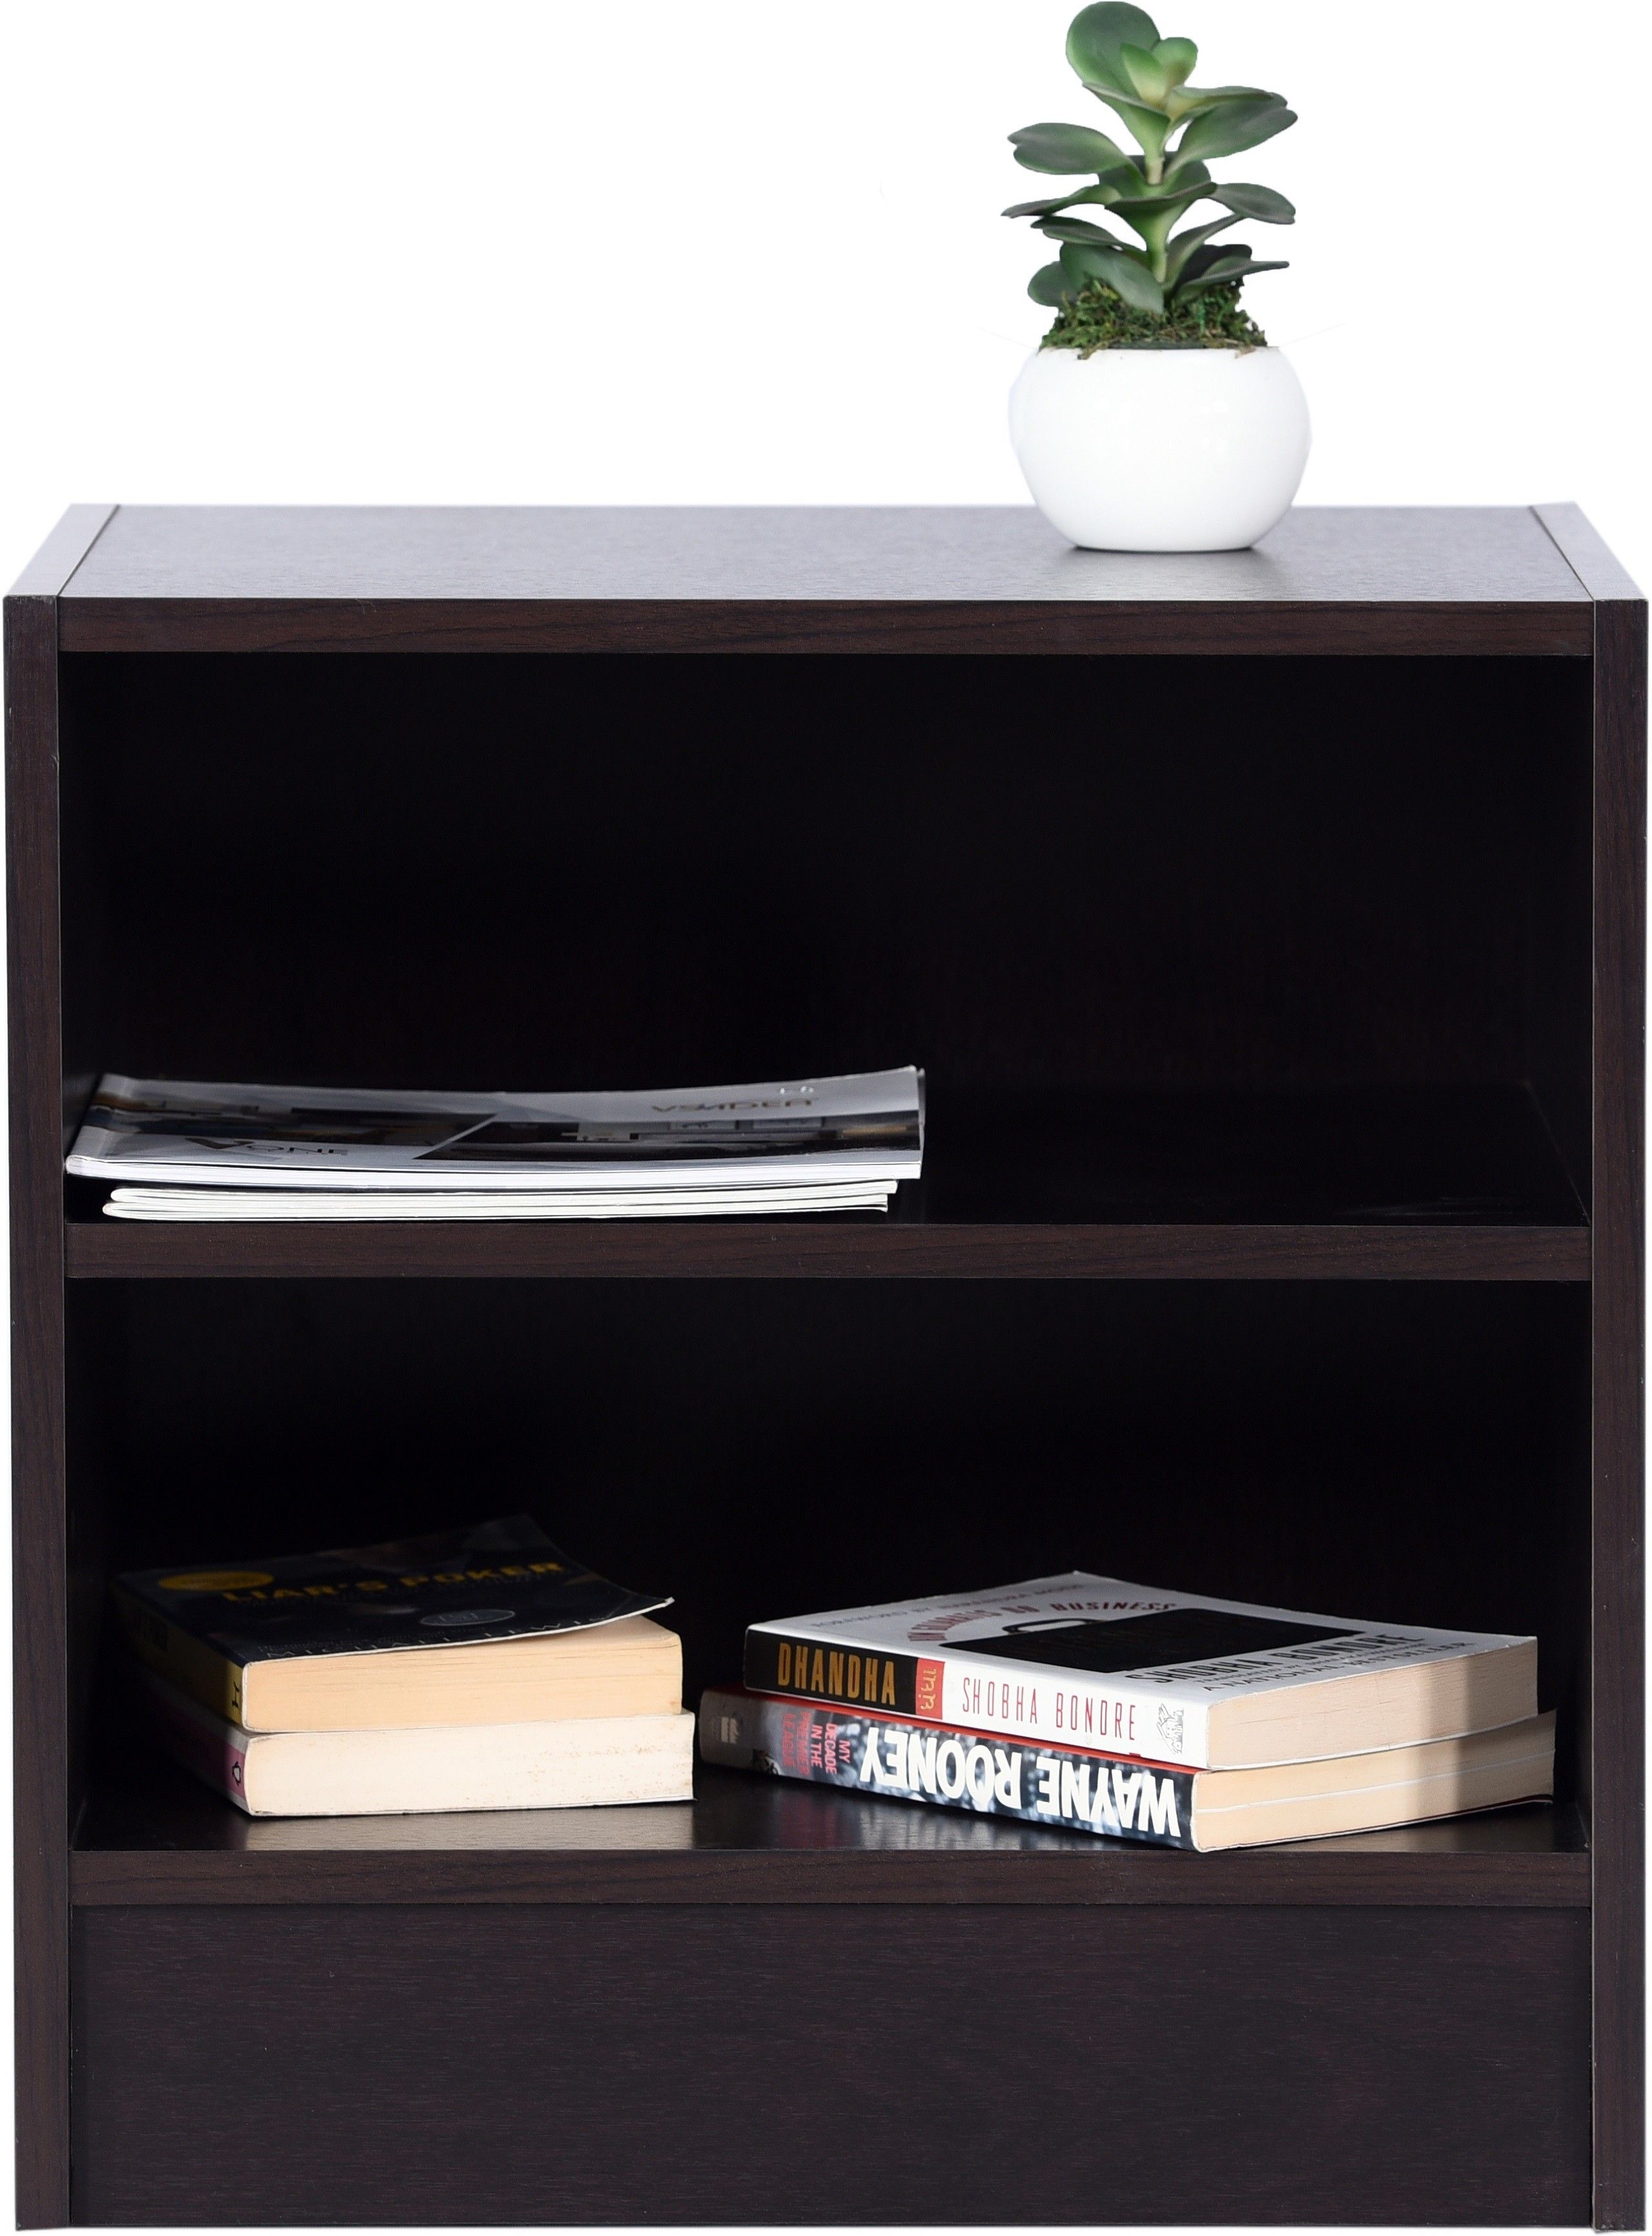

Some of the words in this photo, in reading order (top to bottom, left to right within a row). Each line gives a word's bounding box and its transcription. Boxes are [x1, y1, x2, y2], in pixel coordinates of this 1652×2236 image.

[221, 1579, 389, 1602] LIAR'S
[399, 1561, 564, 1588] POKER
[1049, 1601, 1176, 1611] BUSINESS
[777, 1642, 896, 1705] DHANDHA
[1125, 1659, 1283, 1683] SHOBHA
[1269, 1633, 1425, 1660] BONDRE
[1221, 1665, 1345, 1687] NATIONAL
[1341, 1641, 1475, 1667] BESTSELLER
[810, 1724, 823, 1740] IN
[962, 1676, 1038, 1725] SHOBHA
[1055, 1692, 1136, 1741] BONDRE
[782, 1713, 797, 1768] LEAGUE
[797, 1711, 811, 1776] PREMIER
[810, 1742, 823, 1769] THE
[824, 1723, 838, 1775] DECADE
[838, 1740, 851, 1763] MY
[859, 1726, 1022, 1810] ROONEY
[1036, 1756, 1182, 1838] WAYNE
